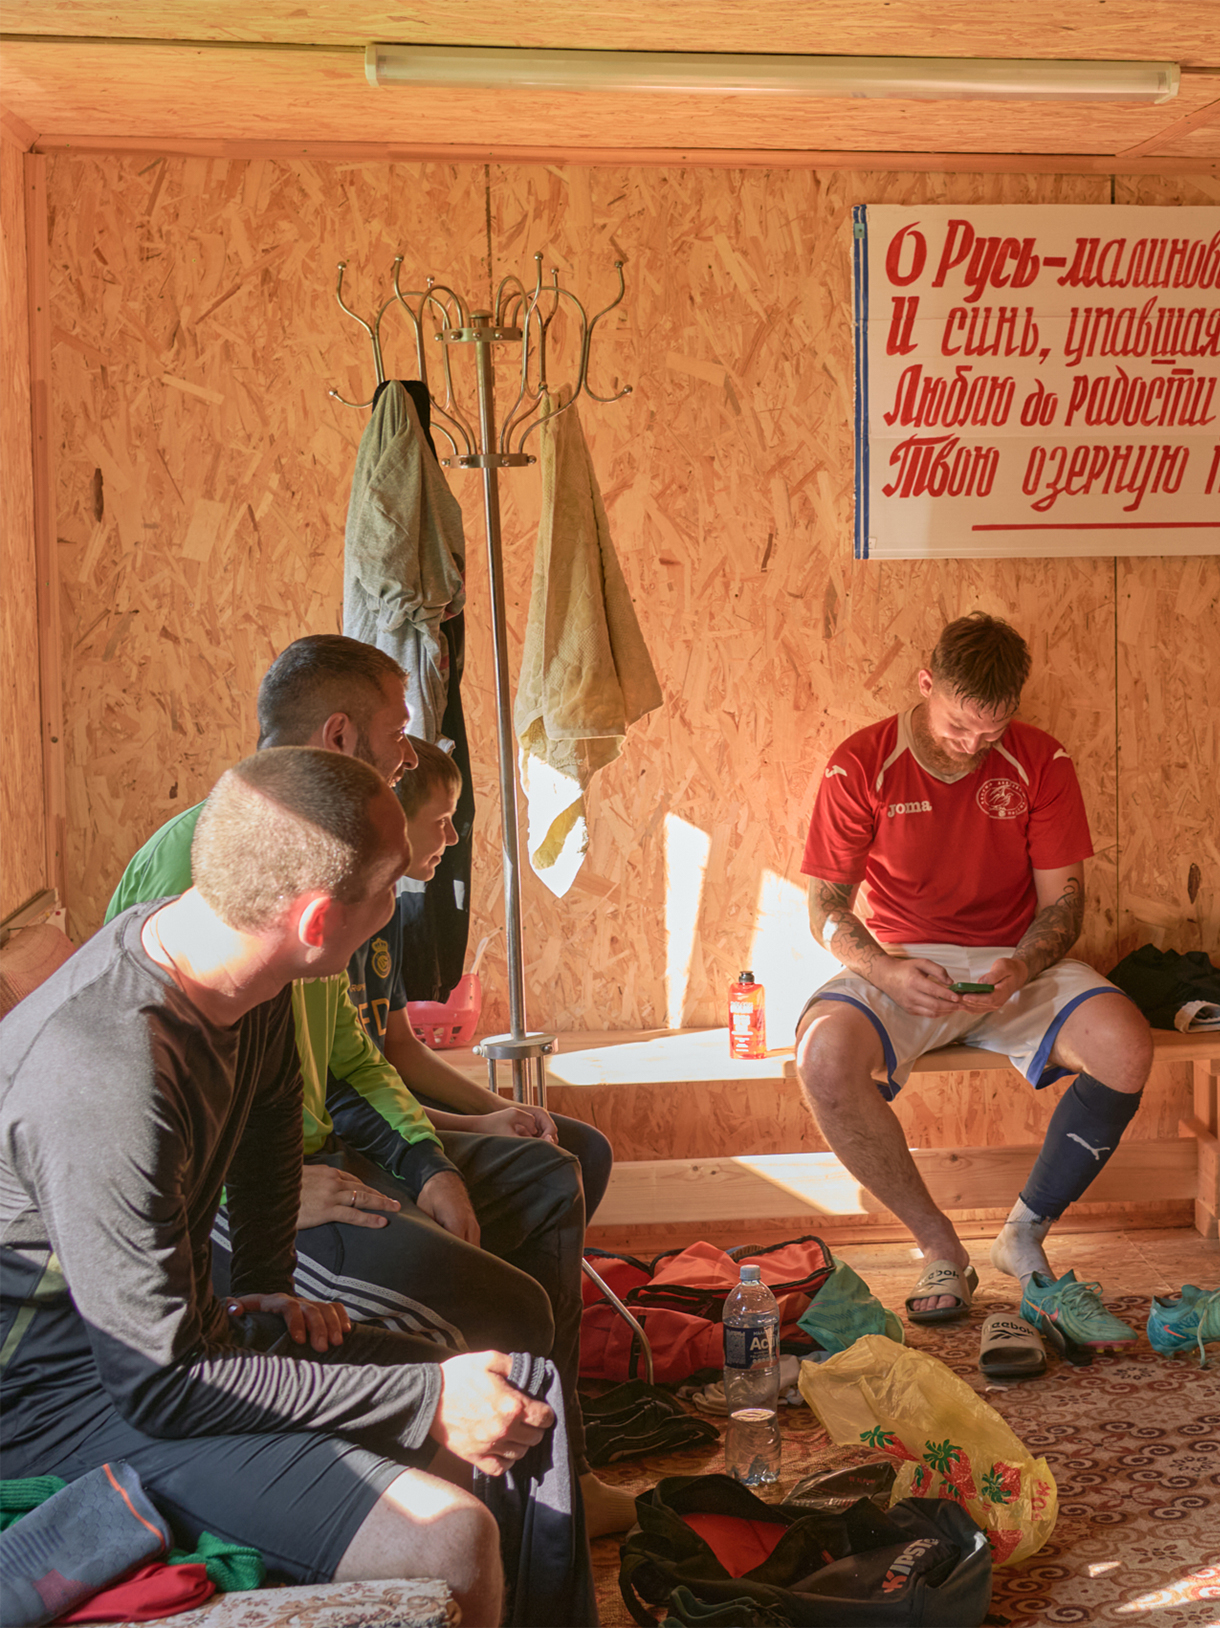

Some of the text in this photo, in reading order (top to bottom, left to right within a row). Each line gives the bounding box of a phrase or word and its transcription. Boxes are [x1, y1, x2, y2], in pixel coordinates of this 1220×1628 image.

[886, 296, 921, 357] И
[941, 306, 1052, 365] синь,
[883, 364, 1016, 428] Люблю
[1020, 377, 1059, 428] до
[1064, 365, 1218, 428] радости
[882, 433, 1001, 498] Твою
[1022, 445, 1191, 512] озерную
